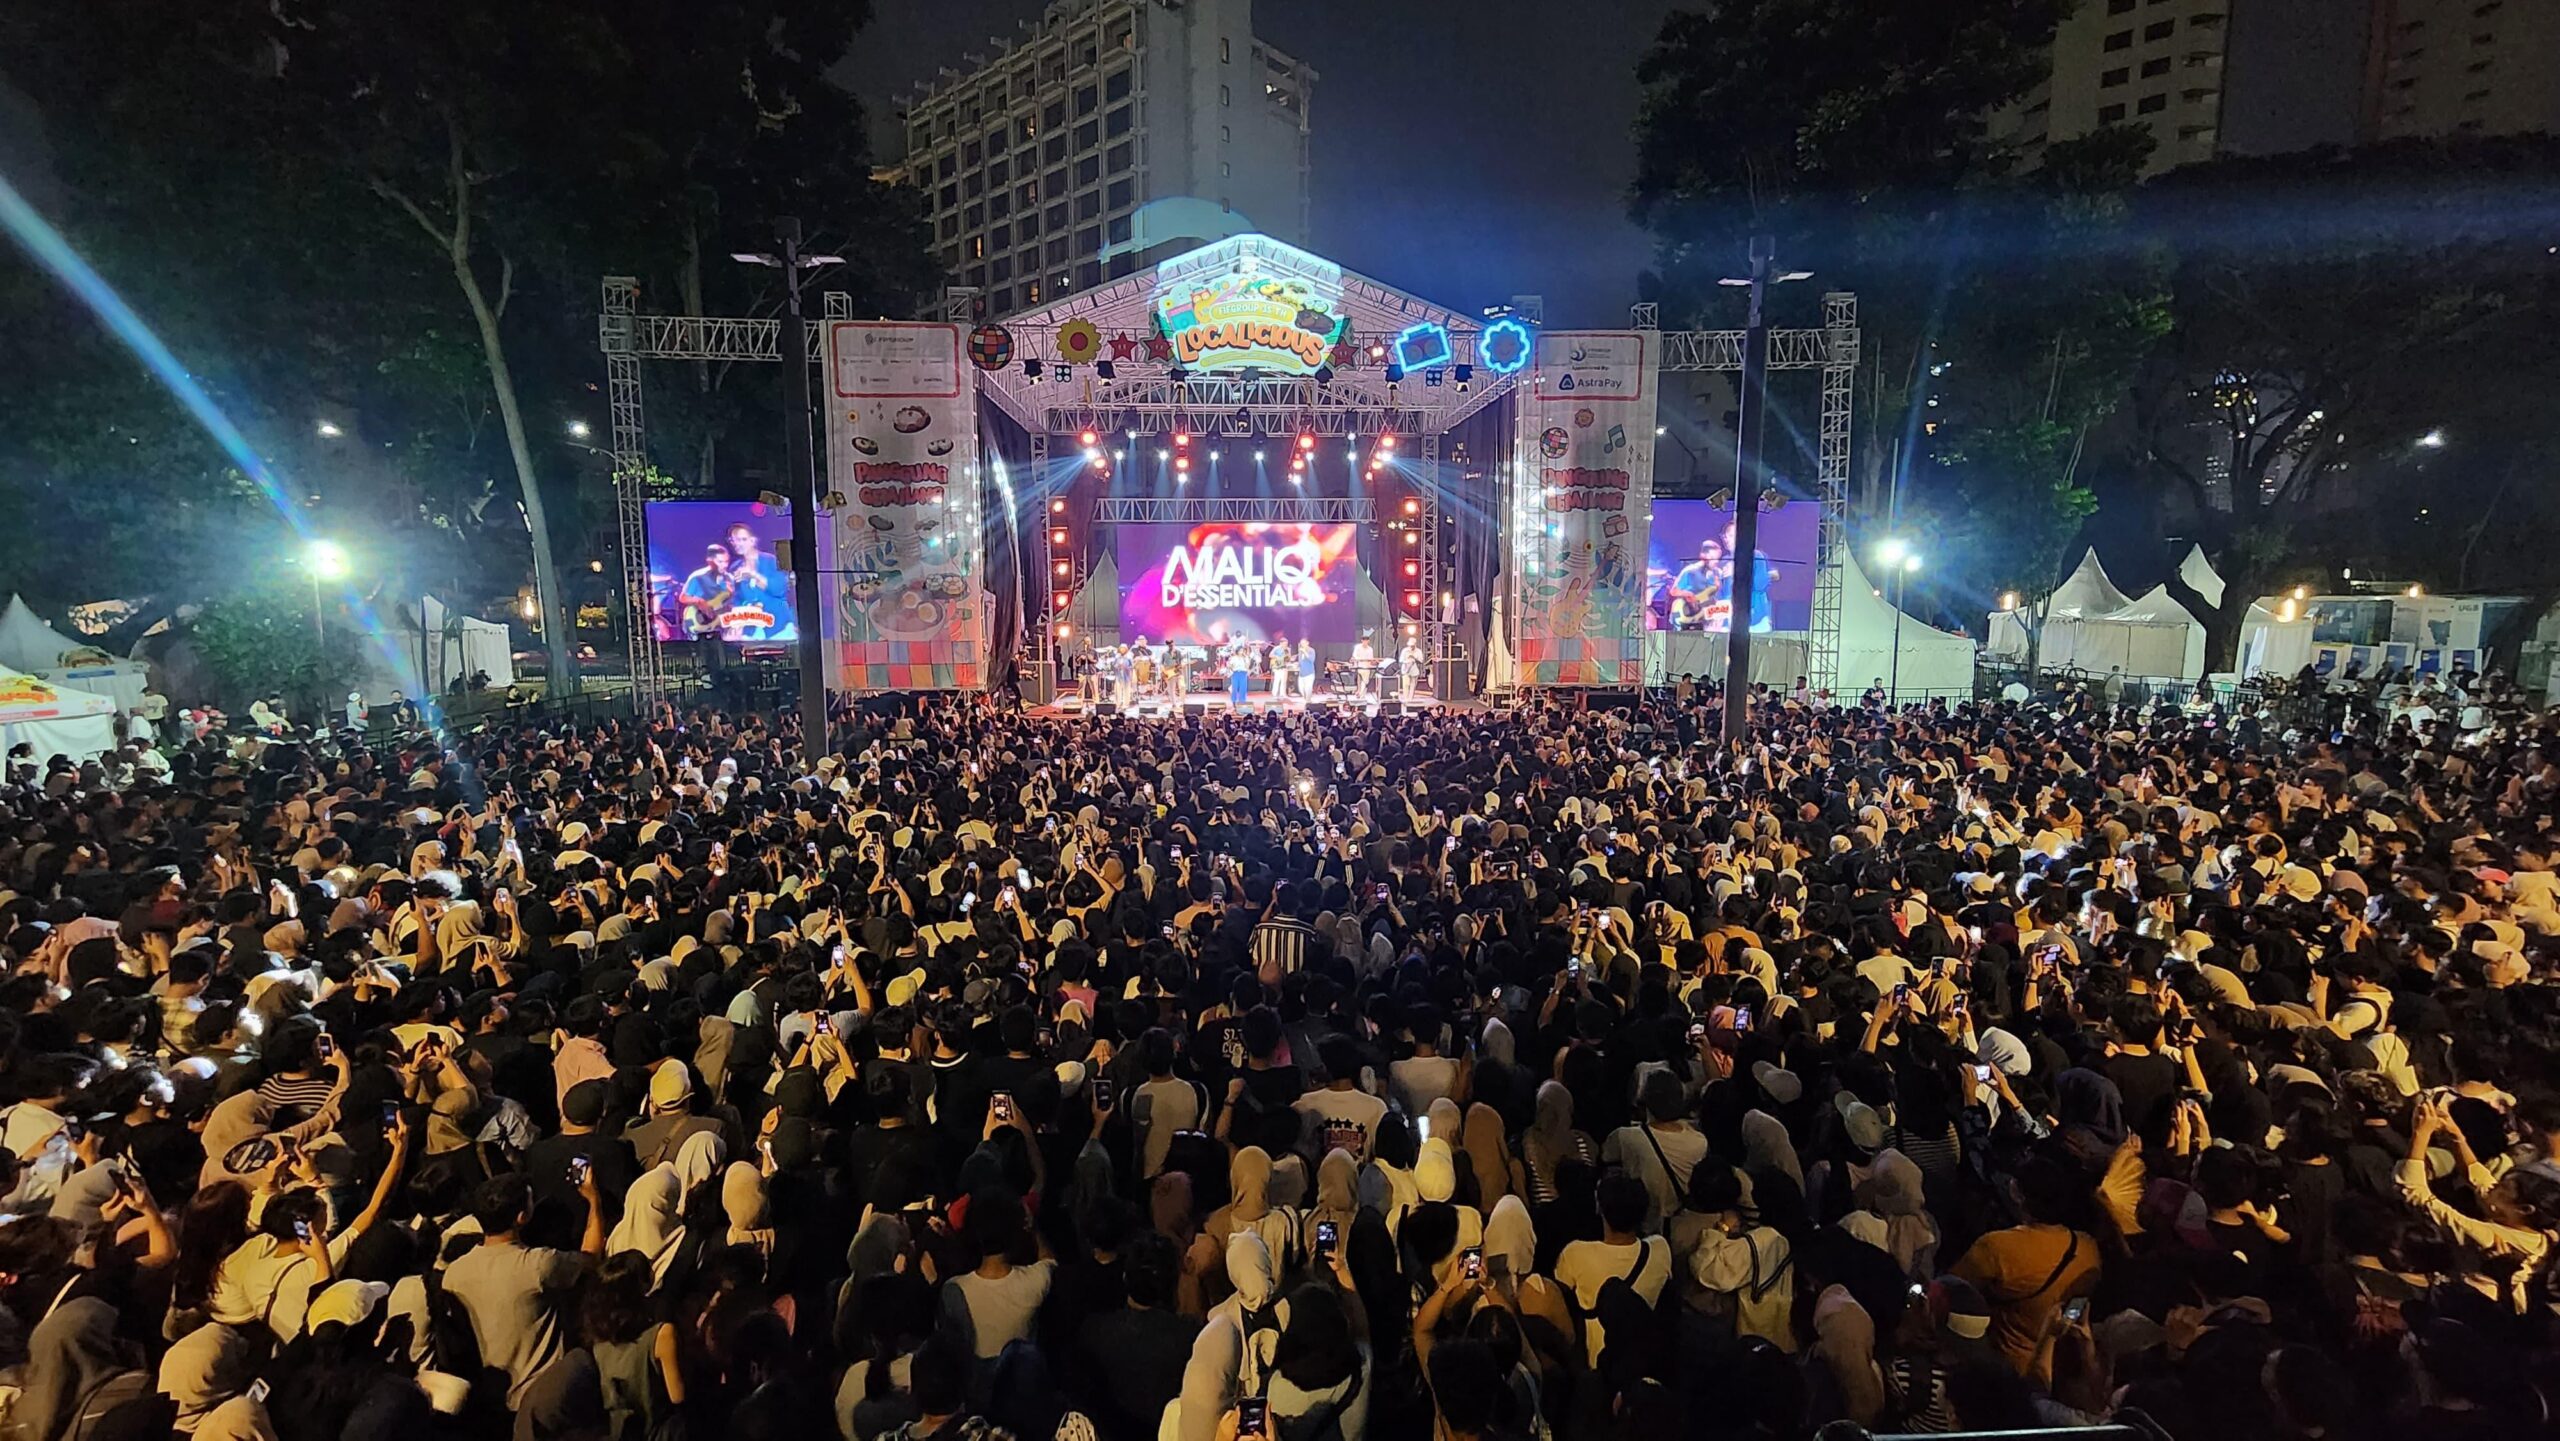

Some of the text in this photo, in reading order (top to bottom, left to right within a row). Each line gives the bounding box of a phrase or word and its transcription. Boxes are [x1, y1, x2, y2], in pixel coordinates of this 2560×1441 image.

[1177, 321, 1324, 367] LOCALICIOUS
[1577, 378, 1622, 390] AstraPay
[854, 462, 949, 485] PANGGUNG
[1541, 467, 1630, 491] PANGGUNG
[1161, 545, 1312, 584] MALIQ
[1162, 584, 1313, 609] D'ESSENTIALS
